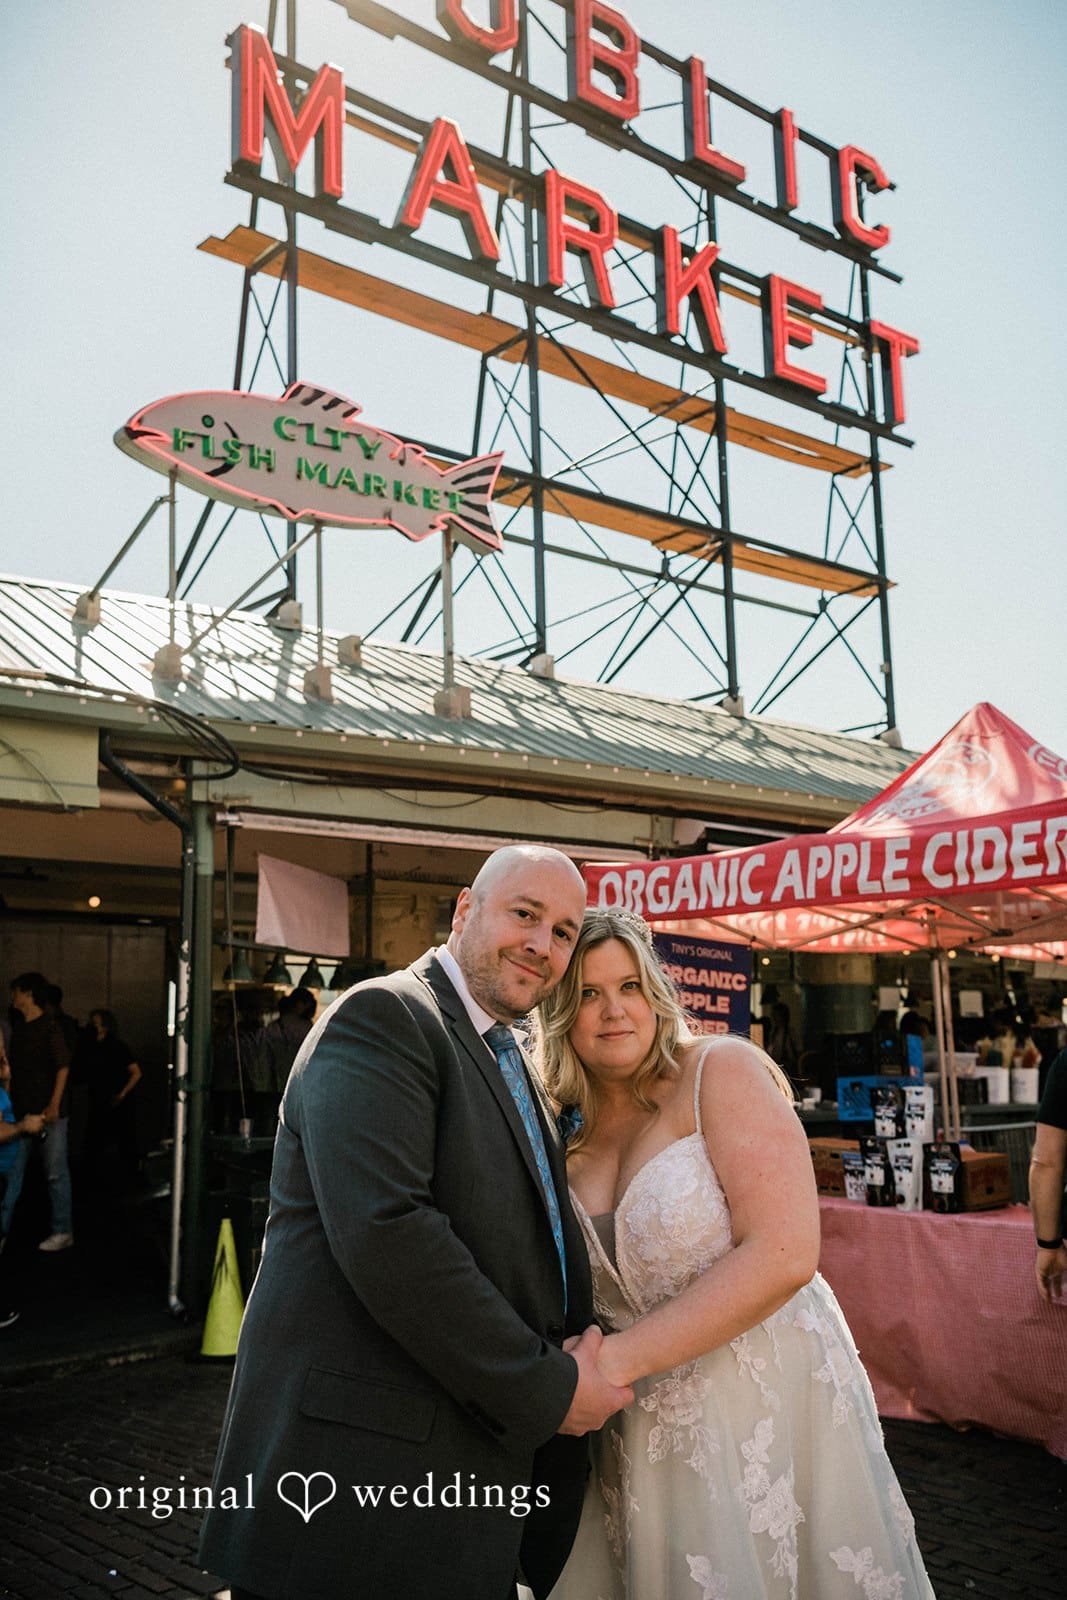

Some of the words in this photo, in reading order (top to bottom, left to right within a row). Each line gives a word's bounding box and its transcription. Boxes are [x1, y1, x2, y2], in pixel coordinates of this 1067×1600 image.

[230, 24, 919, 424] MARKET
[273, 415, 382, 460] CITY
[172, 427, 277, 473] FISH
[296, 456, 465, 515] MARKET
[599, 853, 765, 914] ORGANIC
[770, 836, 912, 902] APPLE
[921, 815, 1067, 889] CIDER
[671, 942, 696, 956] TINY'S
[696, 946, 733, 961] ORIGINAL
[675, 990, 730, 1014] PPLE
